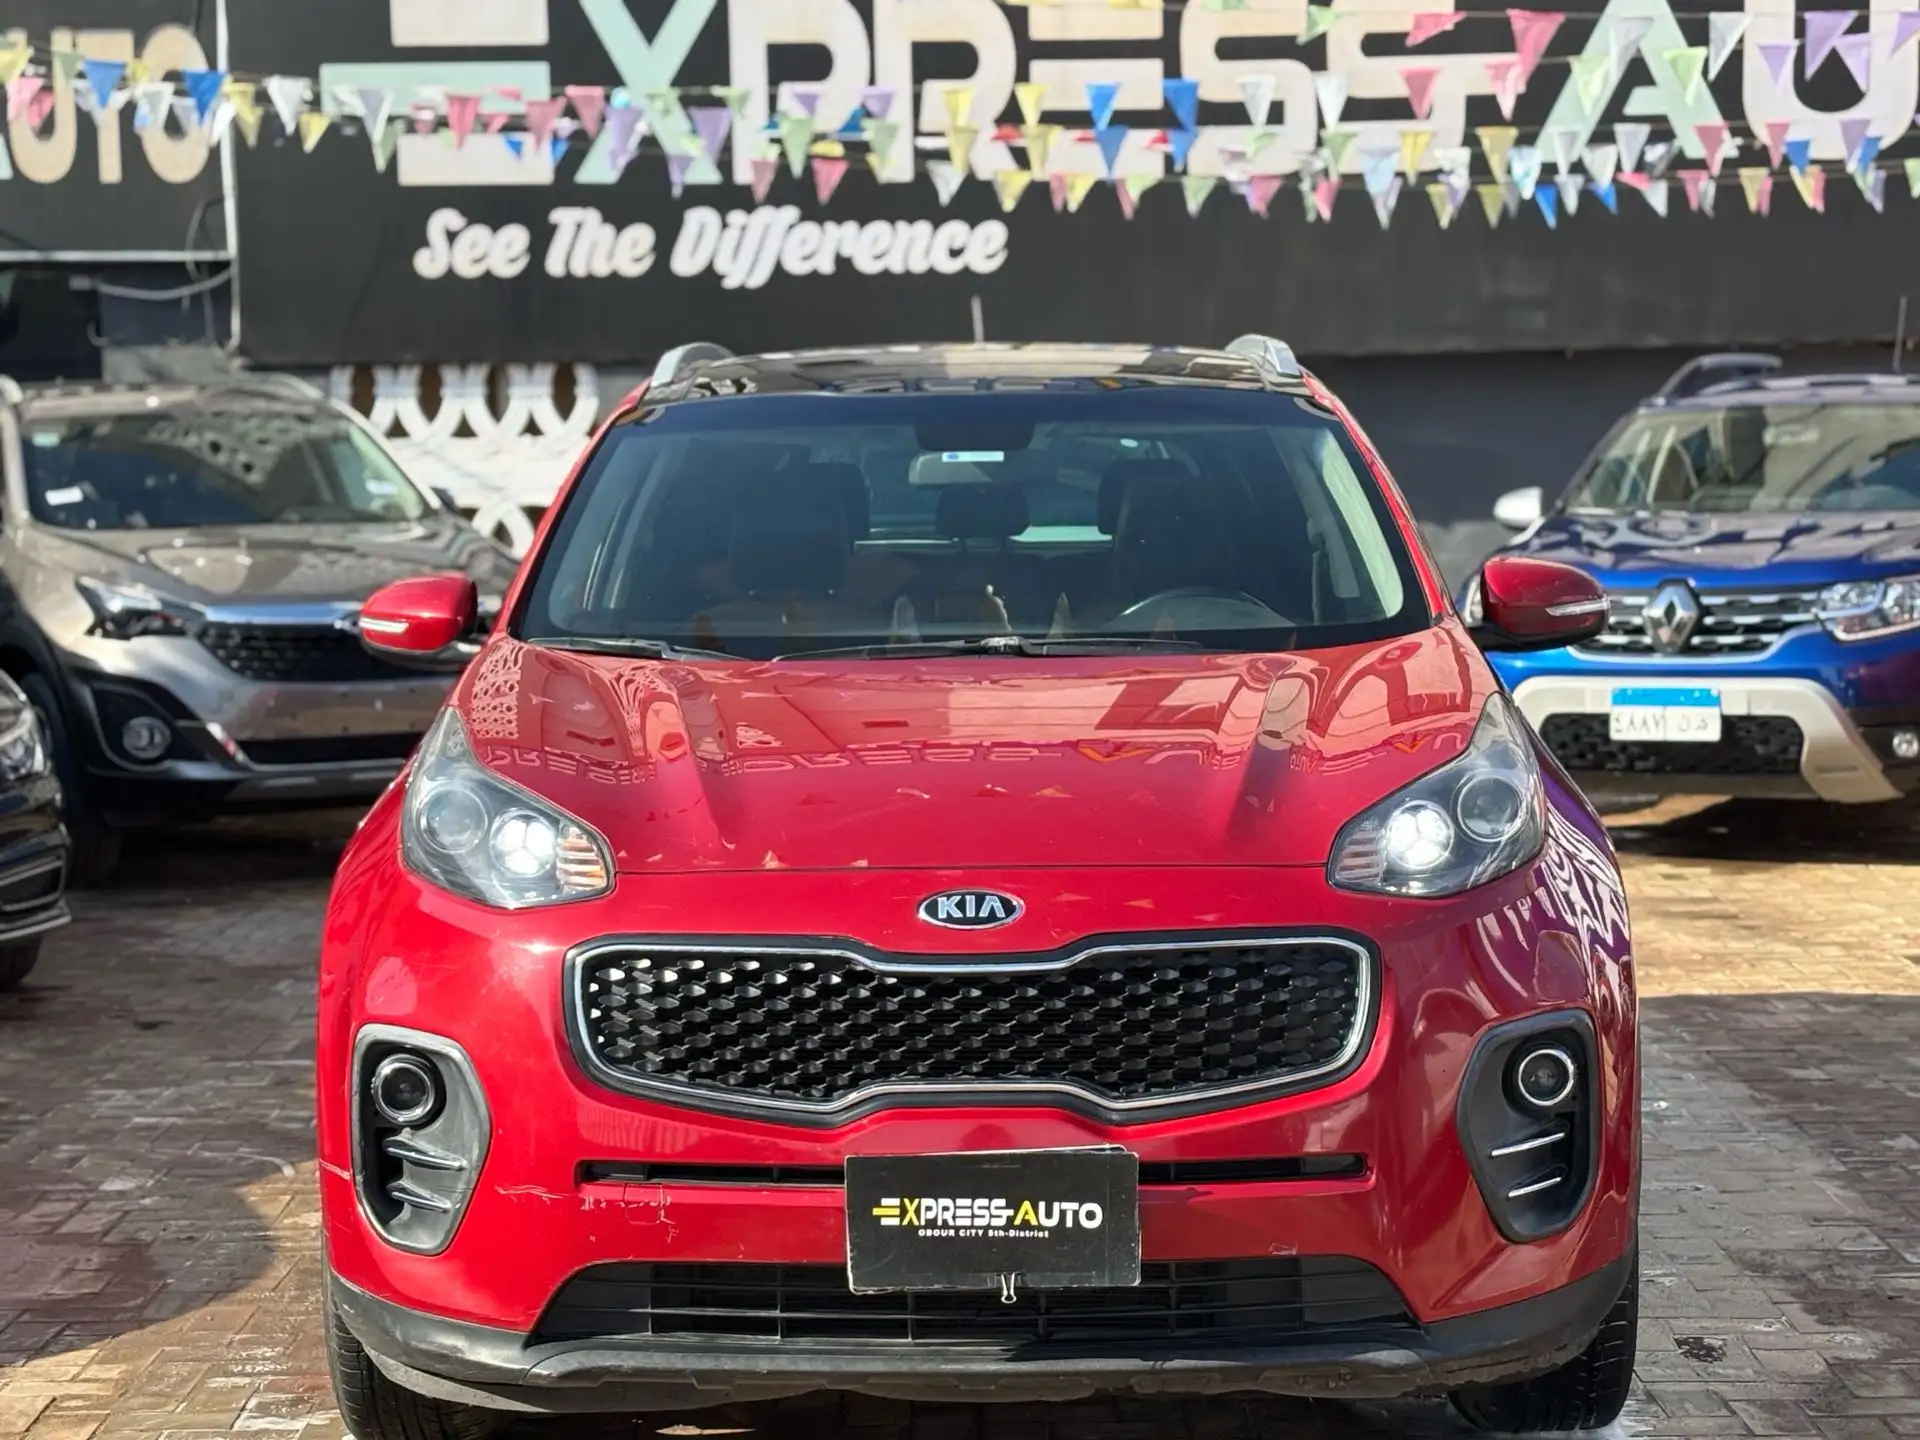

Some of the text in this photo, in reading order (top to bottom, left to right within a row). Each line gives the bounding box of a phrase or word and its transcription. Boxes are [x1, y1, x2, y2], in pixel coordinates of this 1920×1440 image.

[0, 25, 210, 184] UTO
[412, 204, 1009, 289] See The Difference
[936, 894, 1007, 919] KIA
[918, 1228, 956, 1237] OBOUR
[959, 1228, 984, 1237] CITY
